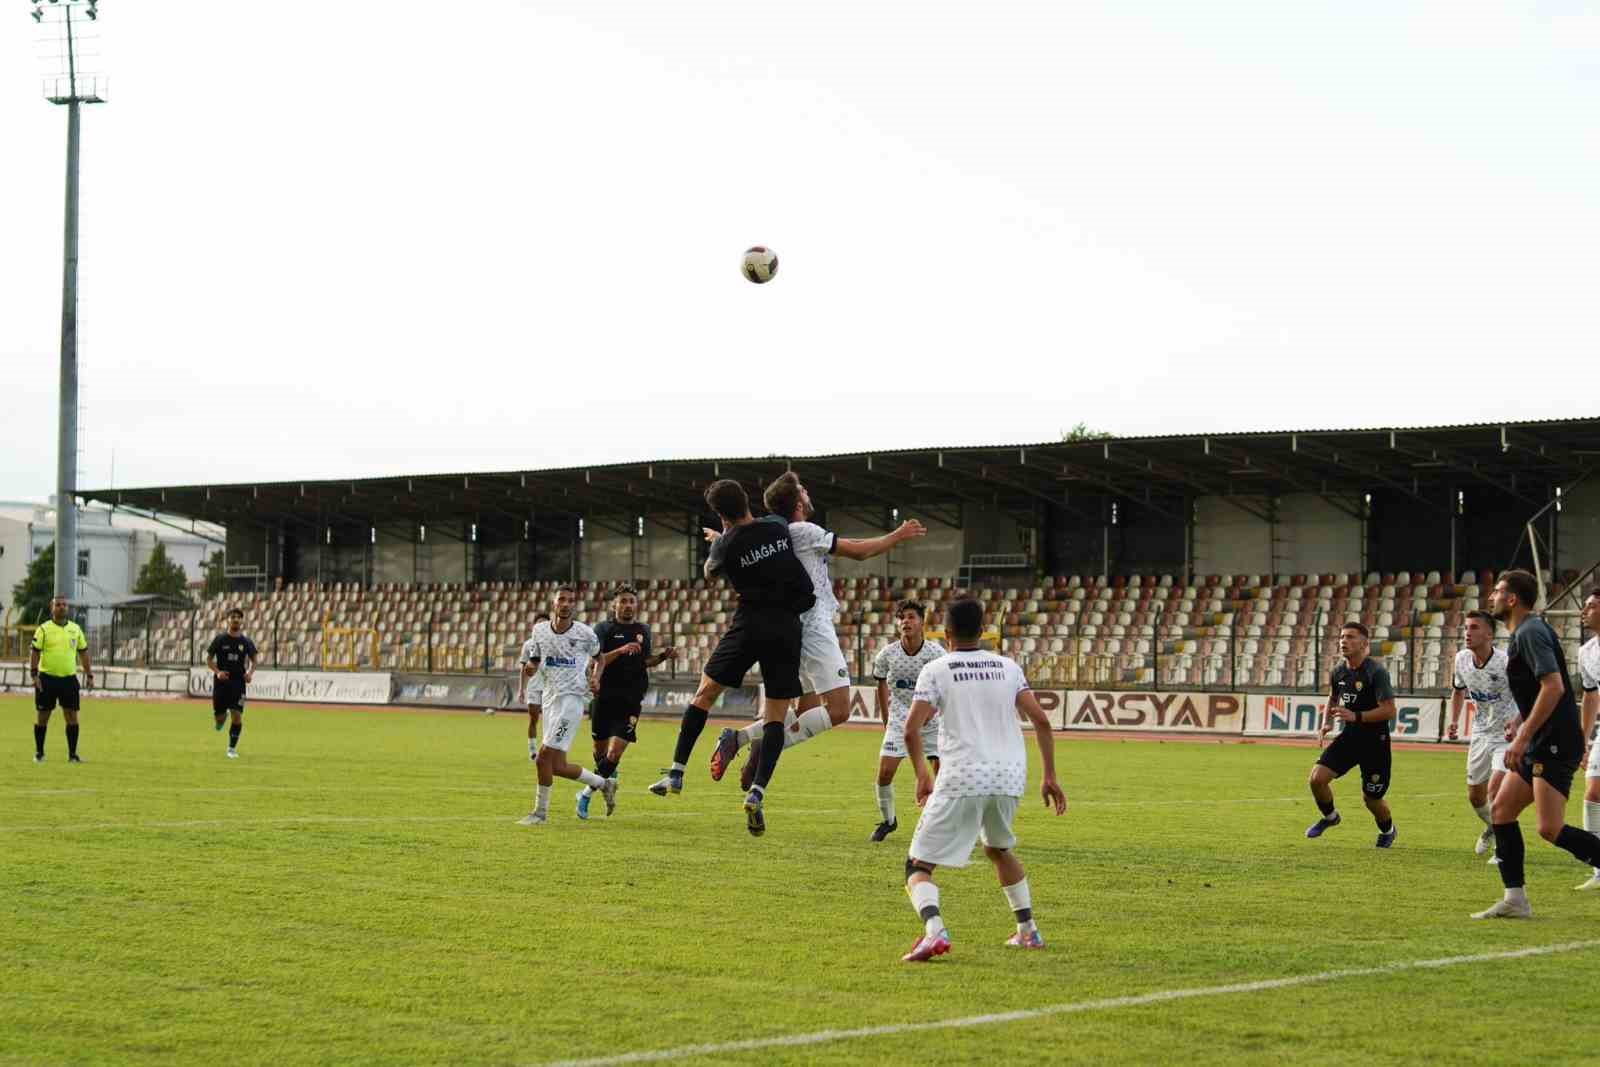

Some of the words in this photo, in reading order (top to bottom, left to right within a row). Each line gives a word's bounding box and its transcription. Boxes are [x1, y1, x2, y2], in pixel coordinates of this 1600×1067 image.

[776, 537, 789, 552] FK
[1343, 693, 1357, 703] 97
[1071, 693, 1240, 728] ARSYAP
[1366, 783, 1383, 793] 97
